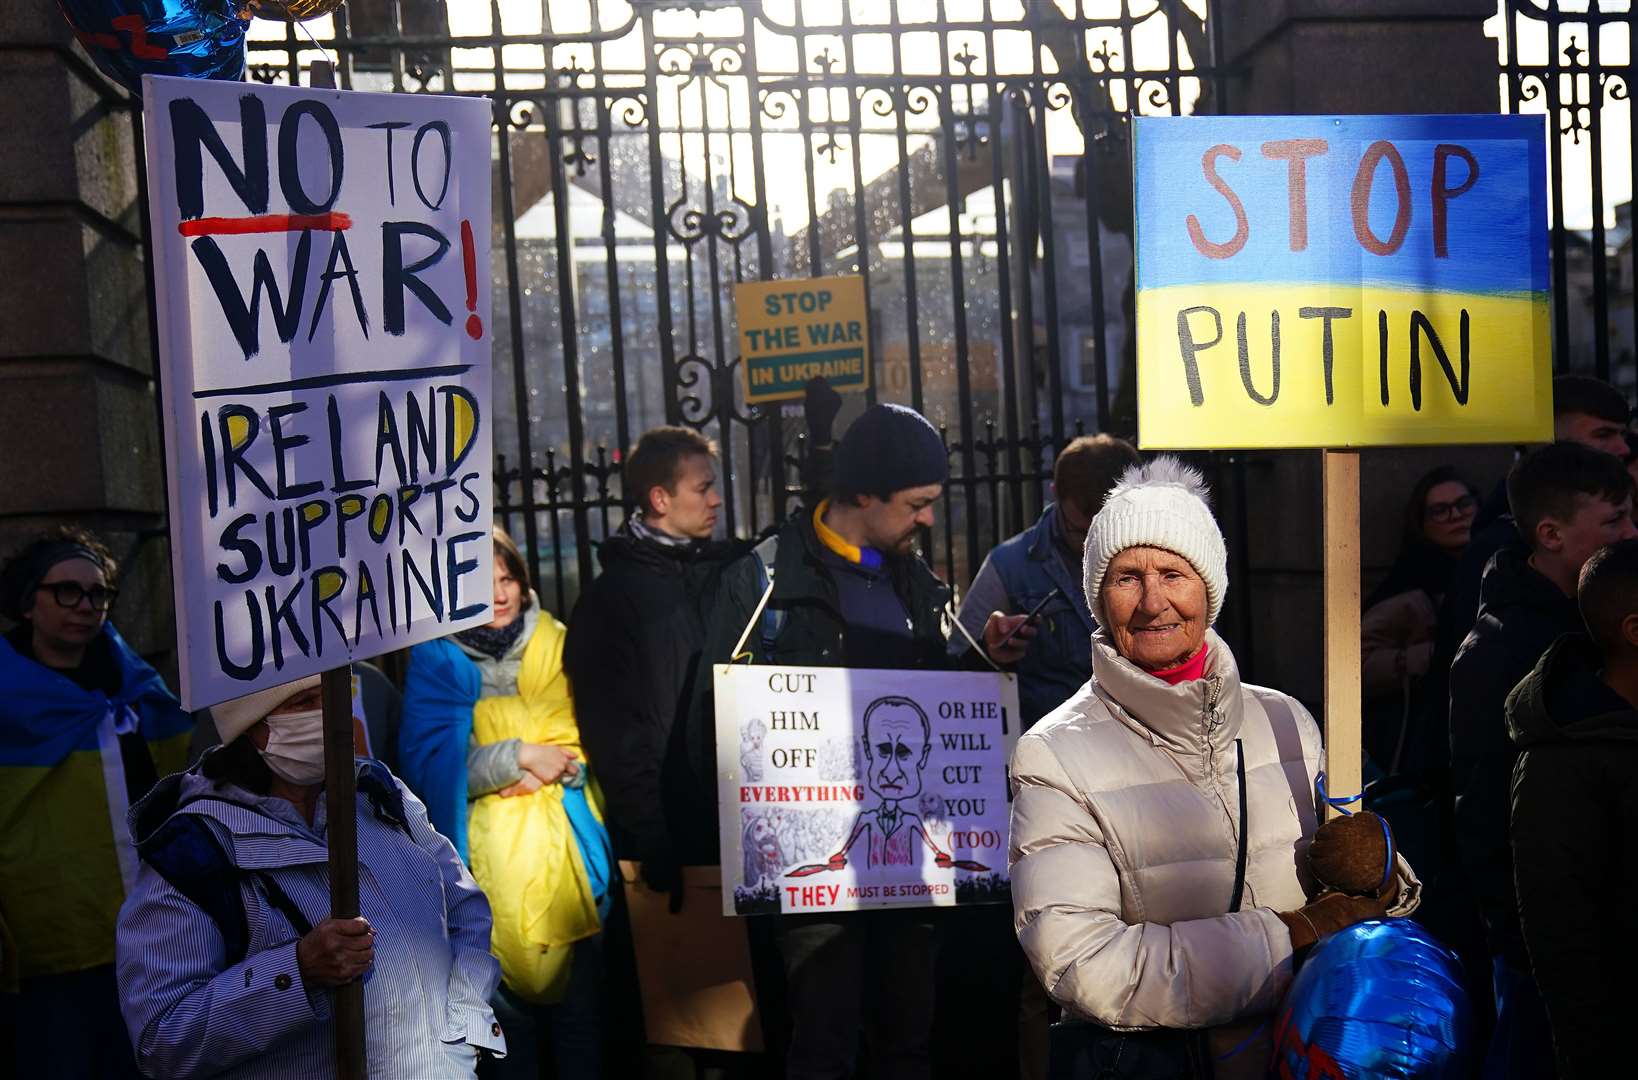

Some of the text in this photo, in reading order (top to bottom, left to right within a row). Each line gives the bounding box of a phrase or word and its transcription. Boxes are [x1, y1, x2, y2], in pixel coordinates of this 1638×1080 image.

[168, 93, 452, 220] NO TO
[1185, 138, 1480, 260] STOP
[191, 218, 484, 360] WAR!
[764, 290, 832, 316] STOP
[745, 320, 863, 352] THE WAR
[1177, 305, 1470, 412] PUTIN
[751, 357, 862, 386] IN UKRAINE
[201, 384, 480, 518] IRELAND
[216, 472, 480, 584] SUPPORTS
[214, 531, 489, 681] UKRAINE
[768, 673, 817, 694] CUT
[770, 711, 820, 731] HIM
[938, 702, 998, 719] OR HE
[940, 733, 992, 751] WILL
[771, 748, 818, 769] OFF
[942, 766, 982, 784] CUT
[739, 784, 865, 803] EVERYTHING
[944, 799, 986, 816] YOU
[946, 831, 1001, 850] (TOO)
[785, 884, 949, 907] THEY MUST BE STOPPED
